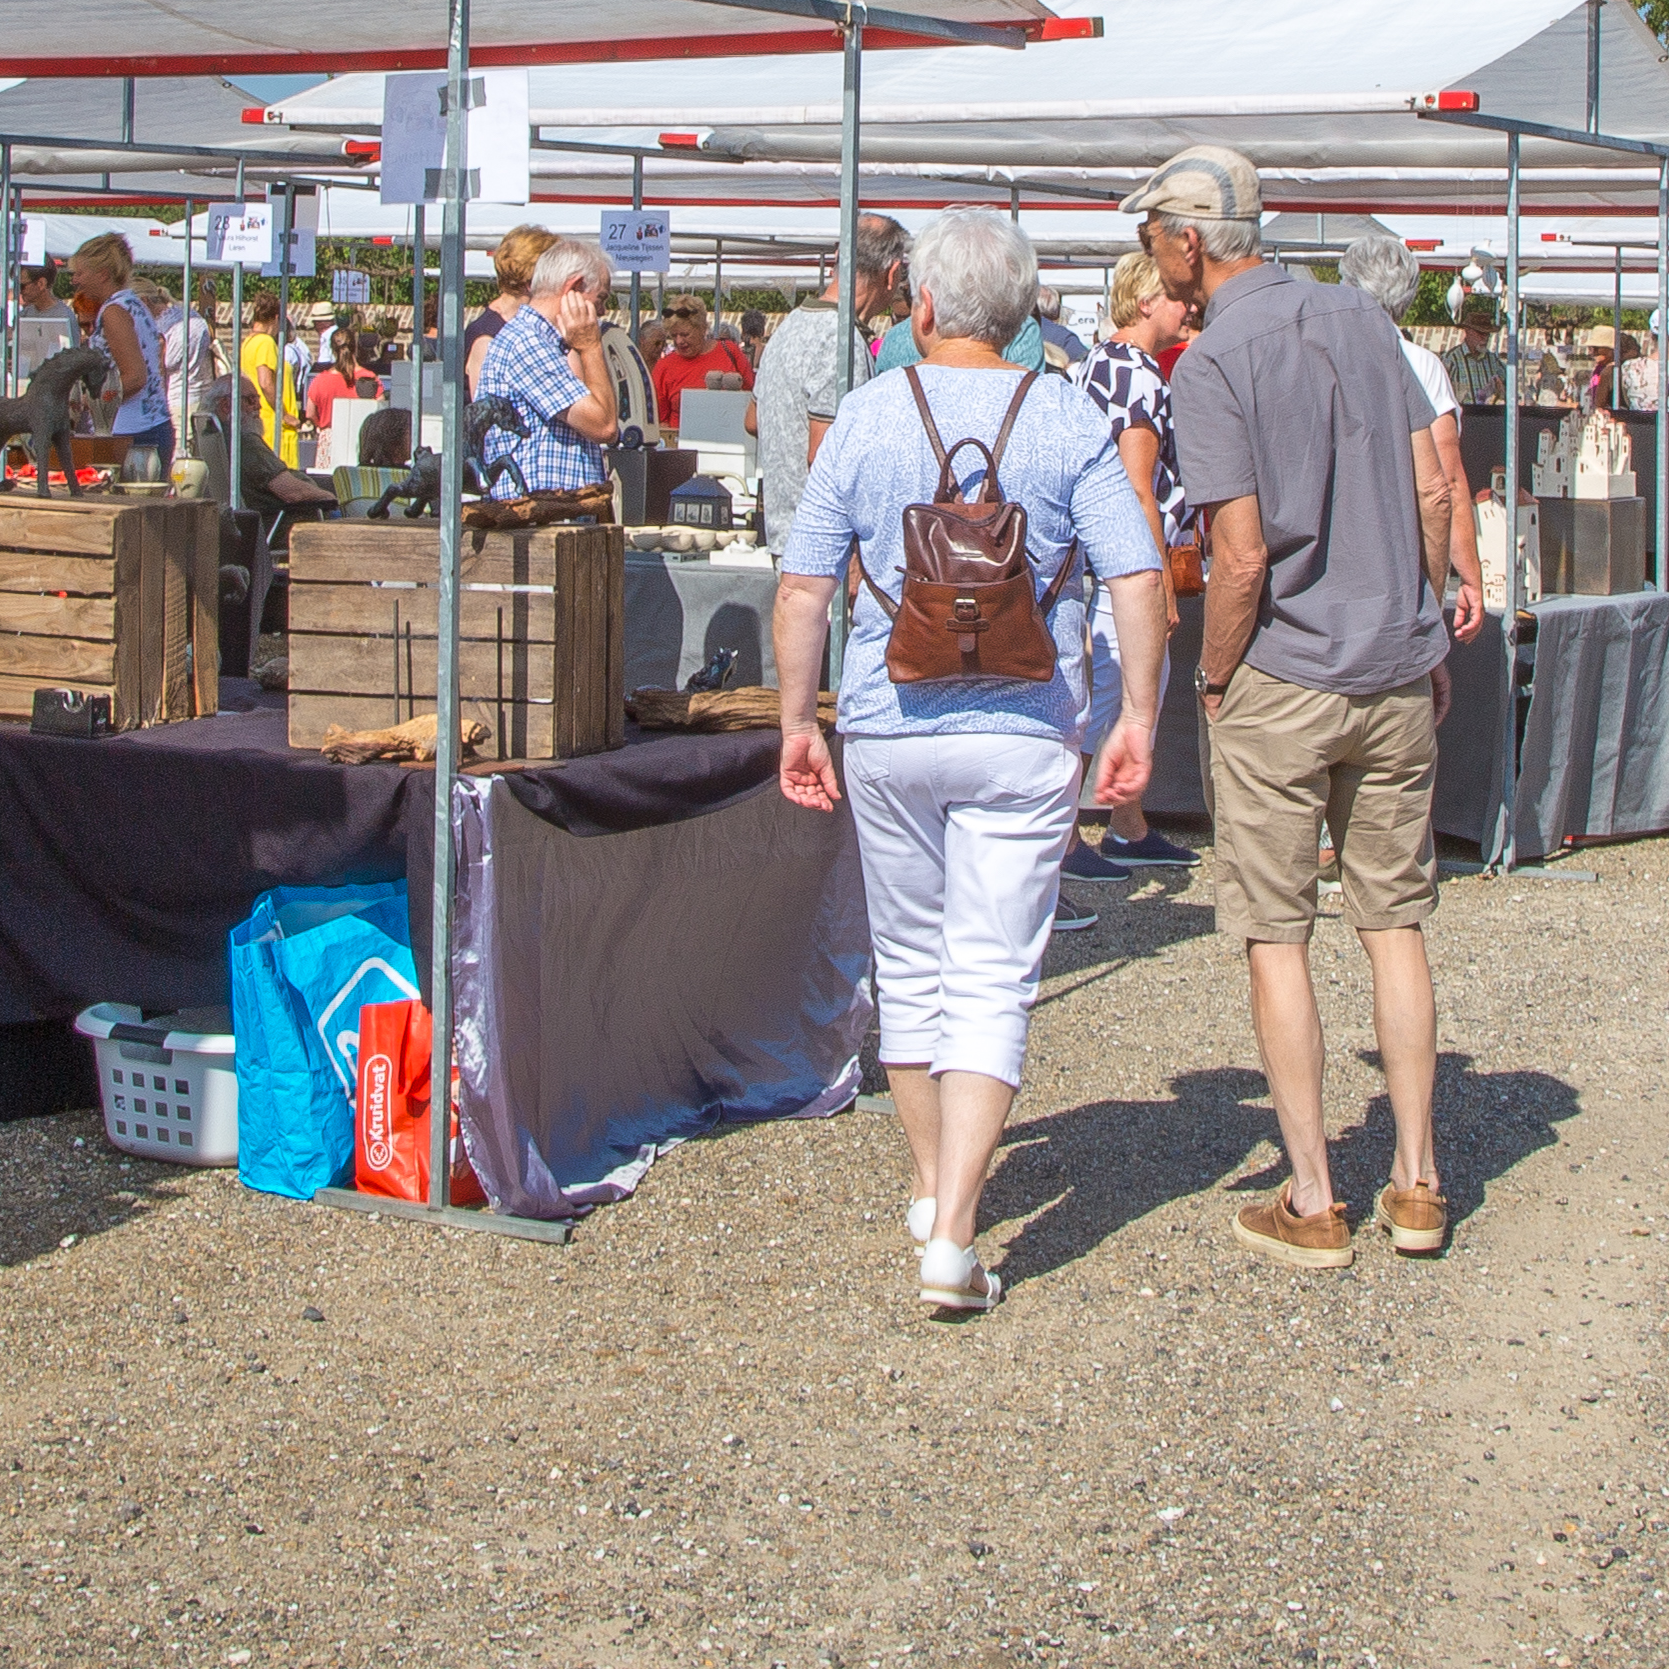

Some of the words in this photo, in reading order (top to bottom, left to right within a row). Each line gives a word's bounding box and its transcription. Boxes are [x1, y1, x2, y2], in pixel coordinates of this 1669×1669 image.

[214, 215, 230, 231] 28
[608, 224, 627, 240] 27
[369, 1064, 387, 1142] Kruidvat
